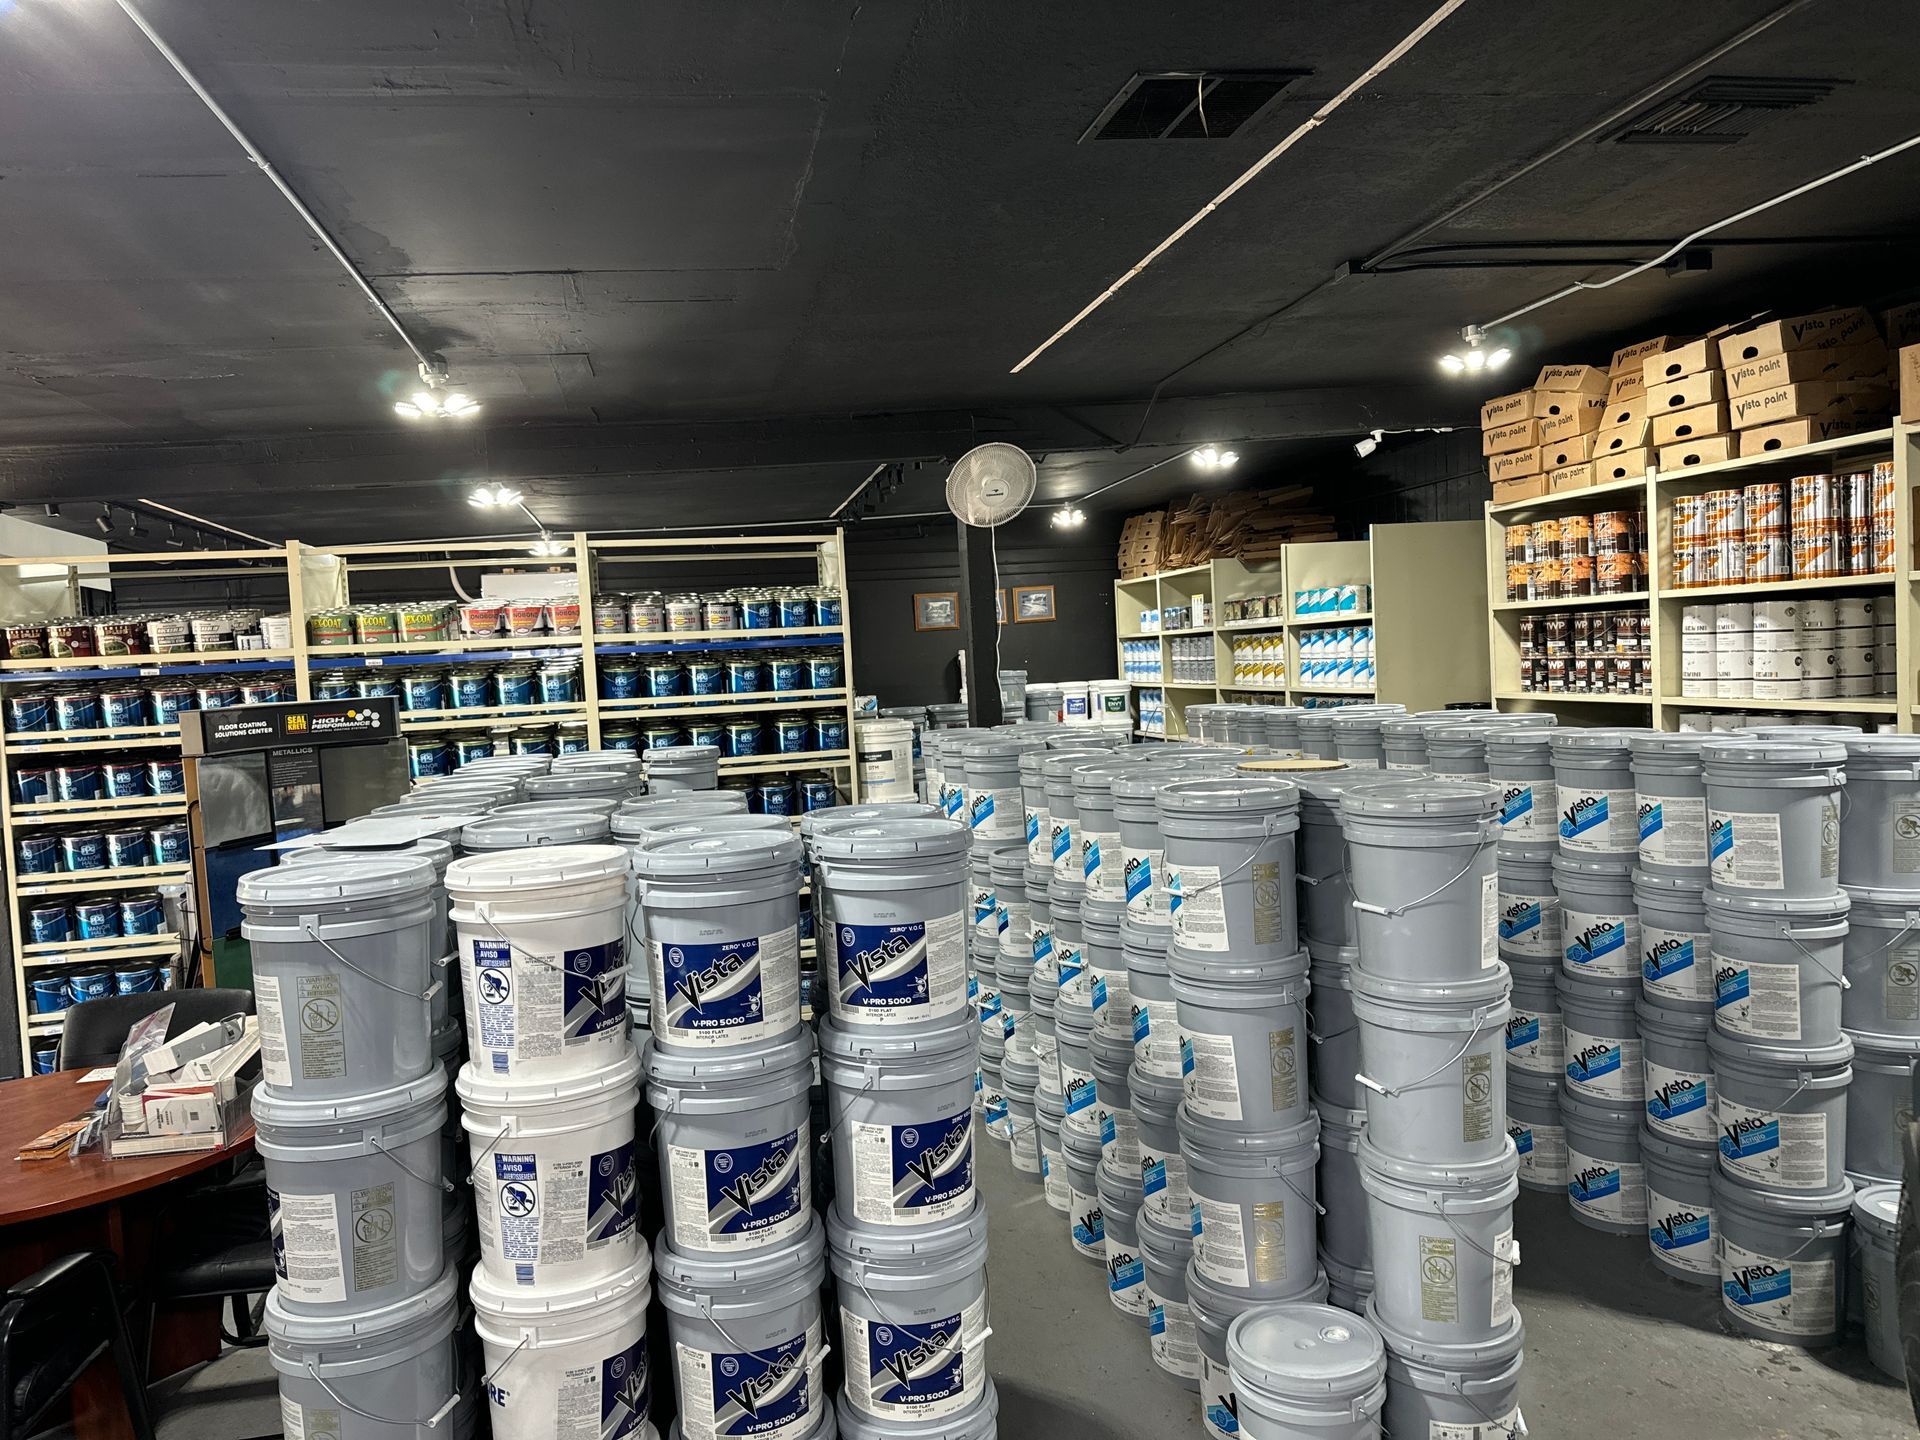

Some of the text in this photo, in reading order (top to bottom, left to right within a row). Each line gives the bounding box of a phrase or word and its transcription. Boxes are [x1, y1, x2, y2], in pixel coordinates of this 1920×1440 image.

[1792, 318, 1824, 342] Vista
[1818, 332, 1838, 348] ista
[1617, 341, 1658, 368] Vista paint
[1544, 368, 1582, 384] Vista paint
[1732, 358, 1780, 390] Vista paint
[1616, 378, 1636, 396] Vista
[1486, 398, 1521, 421] Vista paint
[1588, 400, 1607, 408] Vis
[1736, 391, 1788, 421] Vista paint
[1540, 414, 1573, 438] Vista paint
[1820, 418, 1850, 439] Vista
[1488, 426, 1526, 447] Vista paint
[1494, 453, 1532, 475] Vista paint
[1552, 467, 1584, 488] Vista paint
[1520, 622, 1533, 631] WP
[1574, 620, 1588, 628] WP
[1521, 661, 1532, 670] WP
[1548, 660, 1564, 669] WP
[1576, 660, 1586, 669] WP
[1617, 660, 1630, 669] WP
[218, 723, 238, 731] FLOOR
[286, 716, 306, 724] SEAL
[287, 722, 307, 731] KRETE
[312, 716, 344, 724] HIGH
[312, 720, 371, 730] PERFORMANCE
[214, 729, 248, 738] SOLUTIONS
[272, 748, 313, 756] METALLICS
[1564, 796, 1598, 830] Vista
[1576, 810, 1598, 822] Acriglo
[479, 941, 510, 950] WARNING
[1576, 922, 1616, 956] Vista
[1592, 935, 1614, 948] Acriglo
[480, 950, 498, 958] AVISO
[1646, 938, 1683, 974] Vista
[1660, 952, 1682, 966] Acriglo
[846, 935, 912, 994] Vista
[674, 952, 745, 1016] Vista
[862, 996, 912, 1006] V-PRO 5000
[595, 1016, 614, 1030] V-PRO
[692, 1016, 744, 1028] V-PRO 5000
[1506, 1016, 1531, 1044] Vista
[1573, 1044, 1611, 1078] Vista
[1588, 1057, 1610, 1070] Acriglo
[1064, 1078, 1088, 1104] Vista
[1654, 1079, 1696, 1114] Vista
[1672, 1094, 1694, 1106] Acriglo
[1724, 1118, 1766, 1154] Vista
[1740, 1132, 1766, 1146] Acriglo
[502, 1154, 534, 1164] WARNING
[906, 1124, 966, 1190] Vista
[502, 1164, 522, 1172] AVISO
[504, 1172, 536, 1180] AVERTISSEMENT
[720, 1148, 790, 1216] Vista
[1574, 1166, 1610, 1198] Vista
[1588, 1178, 1609, 1190] Acriglo
[924, 1184, 965, 1204] V-PRO 5000
[742, 1210, 790, 1230] V-PRO 5000
[1080, 1208, 1104, 1238] Vist
[762, 1226, 773, 1234] FLAT
[1657, 1211, 1699, 1246] Vista
[1674, 1224, 1698, 1238] Acriglo
[1108, 1252, 1134, 1284] Vista
[1732, 1264, 1779, 1302] Vista
[1752, 1280, 1778, 1292] Acriglo
[880, 1330, 951, 1391] Vista
[726, 1352, 798, 1420] Vista
[900, 1390, 950, 1403] V-PRO 5000
[747, 1412, 797, 1433] V-PRO 5000
